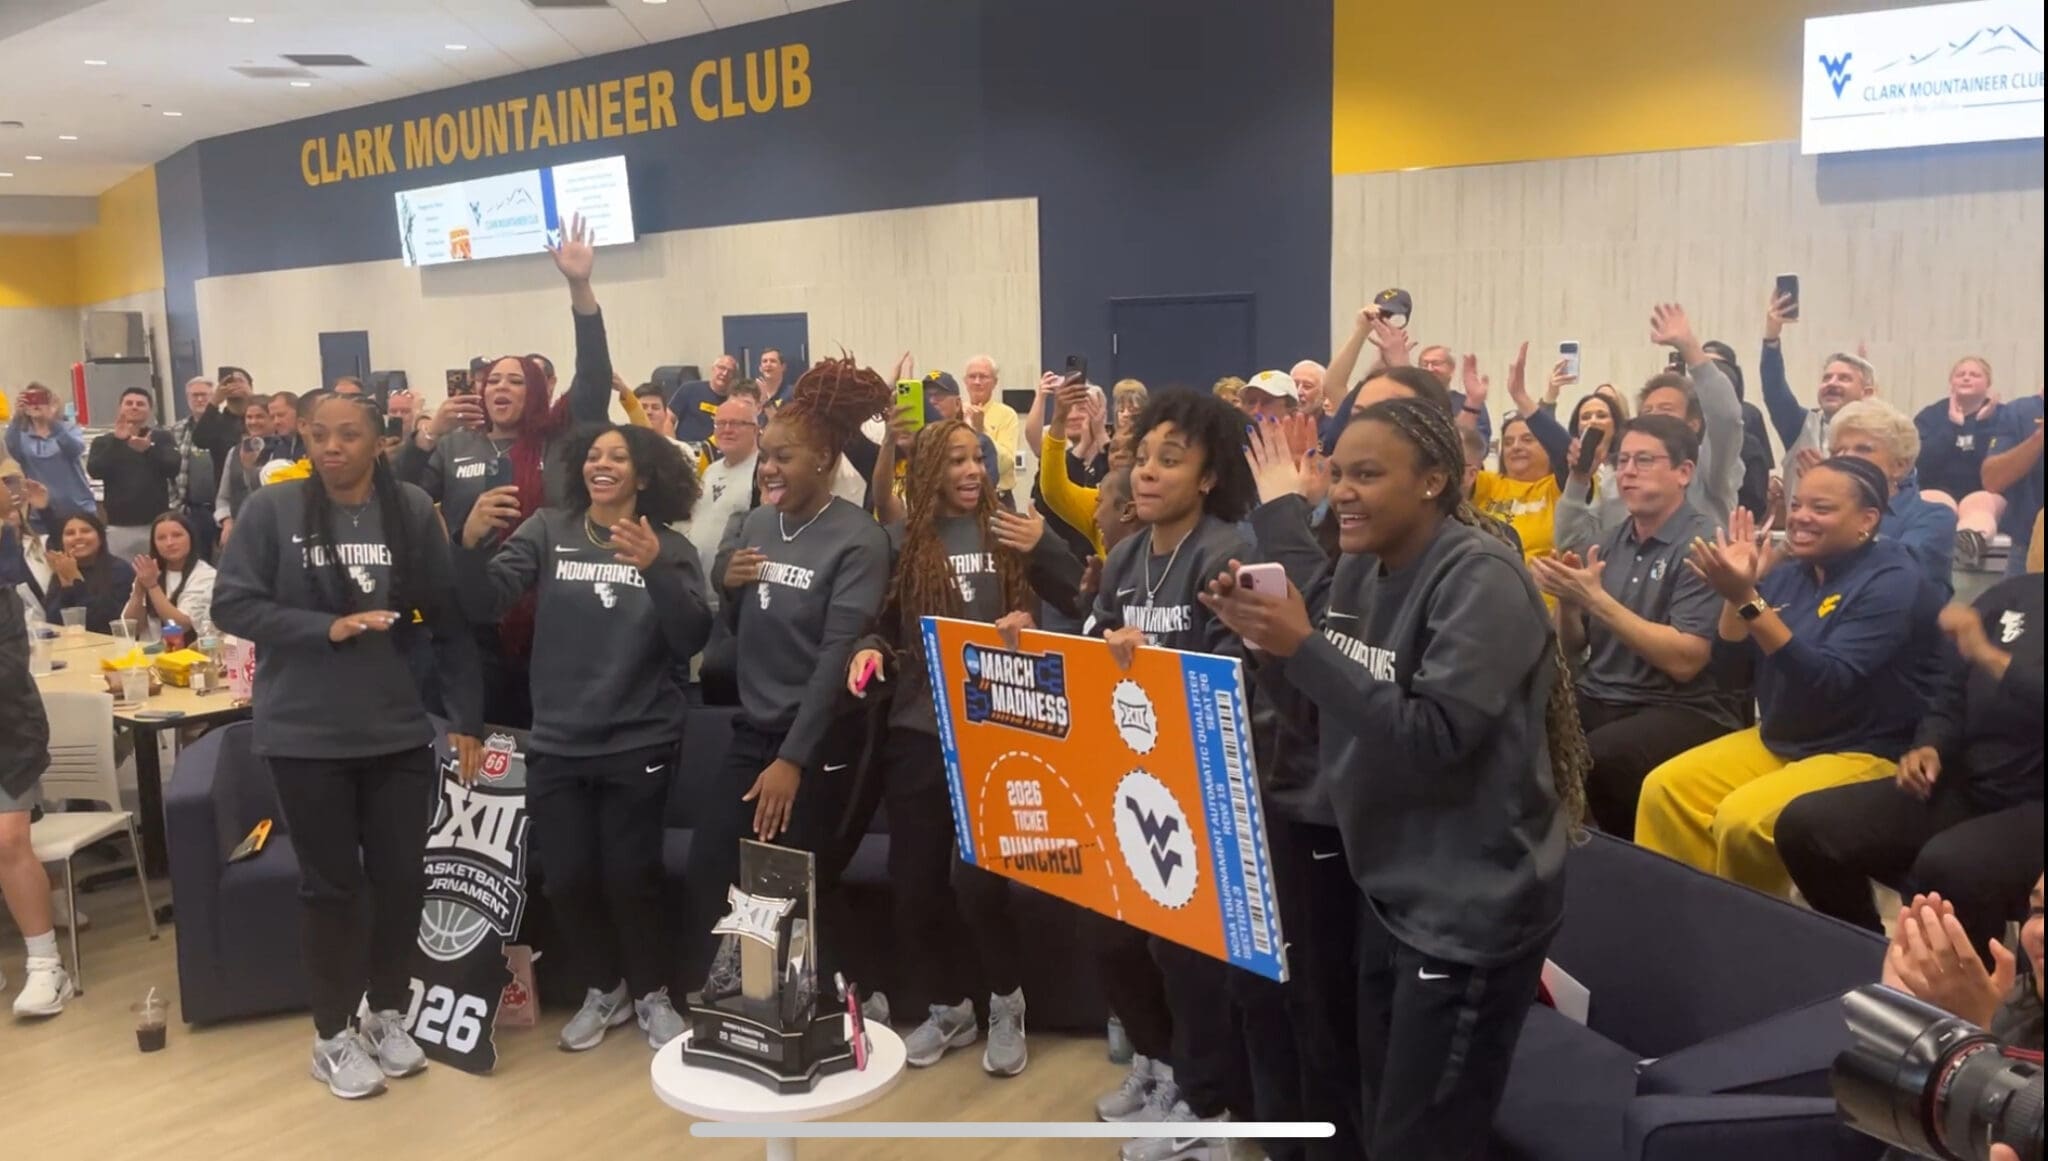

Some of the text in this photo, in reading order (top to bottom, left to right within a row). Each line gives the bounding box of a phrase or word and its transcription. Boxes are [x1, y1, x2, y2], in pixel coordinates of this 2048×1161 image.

[1863, 83, 1906, 102] CLARK
[1910, 74, 2008, 98] MOUNTAINEER
[302, 43, 812, 187] CLARK MOUNTAINEER CLUB
[979, 651, 1036, 689] MARCH
[991, 684, 1068, 726] MADNESS
[1202, 695, 1216, 730] SEAT
[485, 753, 506, 771] 66
[1006, 779, 1043, 807] 2026
[1188, 670, 1242, 958] NCAA TOURNAMENT AUTOMATIC QUALIFIER
[425, 778, 526, 869] XII
[1012, 810, 1049, 832] TICKET
[1218, 802, 1233, 836] ROW
[999, 835, 1083, 875] PUNCHED
[1126, 796, 1183, 888] WV
[425, 862, 510, 904] ASKETBALL
[427, 877, 510, 920] URNAMENT
[1233, 897, 1252, 961] SECTION
[408, 977, 488, 1054] 026
